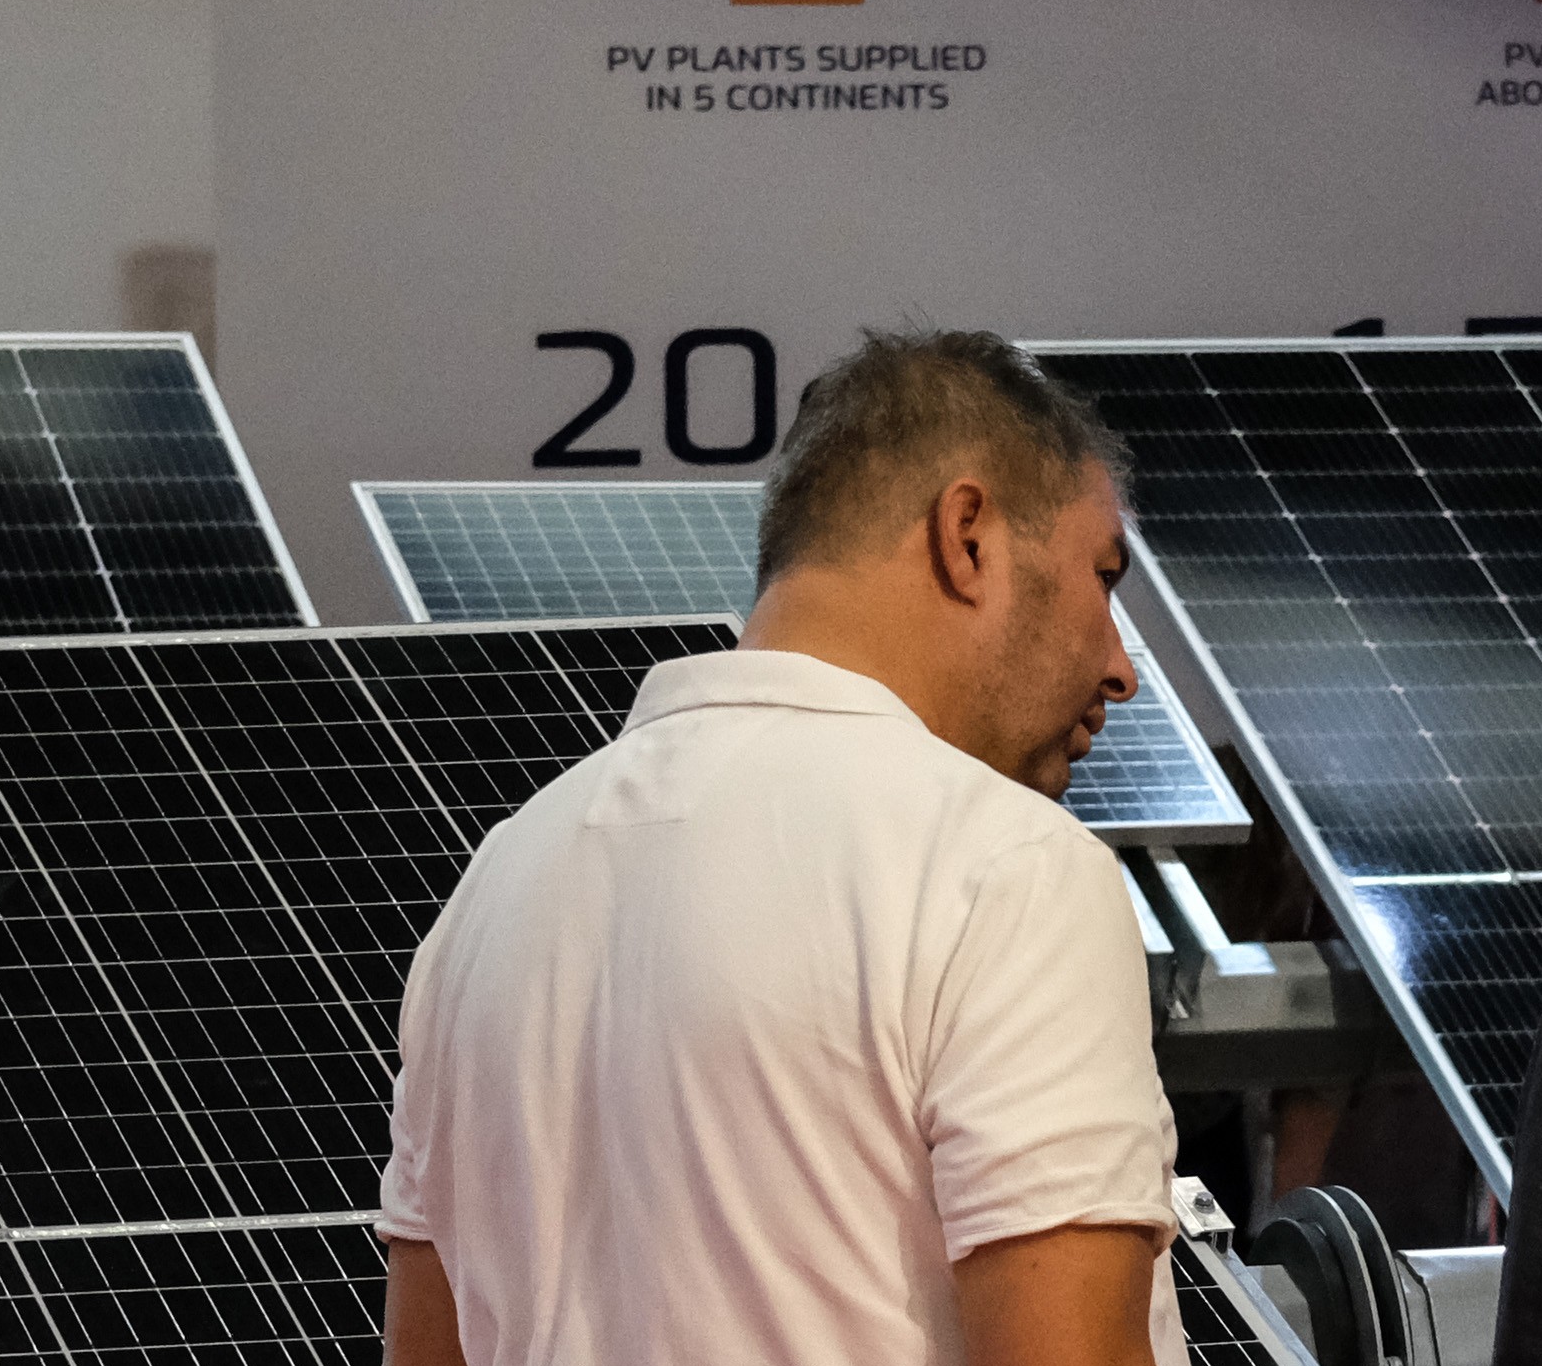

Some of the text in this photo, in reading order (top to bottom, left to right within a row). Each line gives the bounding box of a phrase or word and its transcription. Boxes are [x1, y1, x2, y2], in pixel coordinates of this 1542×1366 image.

[606, 44, 987, 73] PV PLANTS SUPPLIED
[646, 82, 950, 113] IN 5 CONTINENTS
